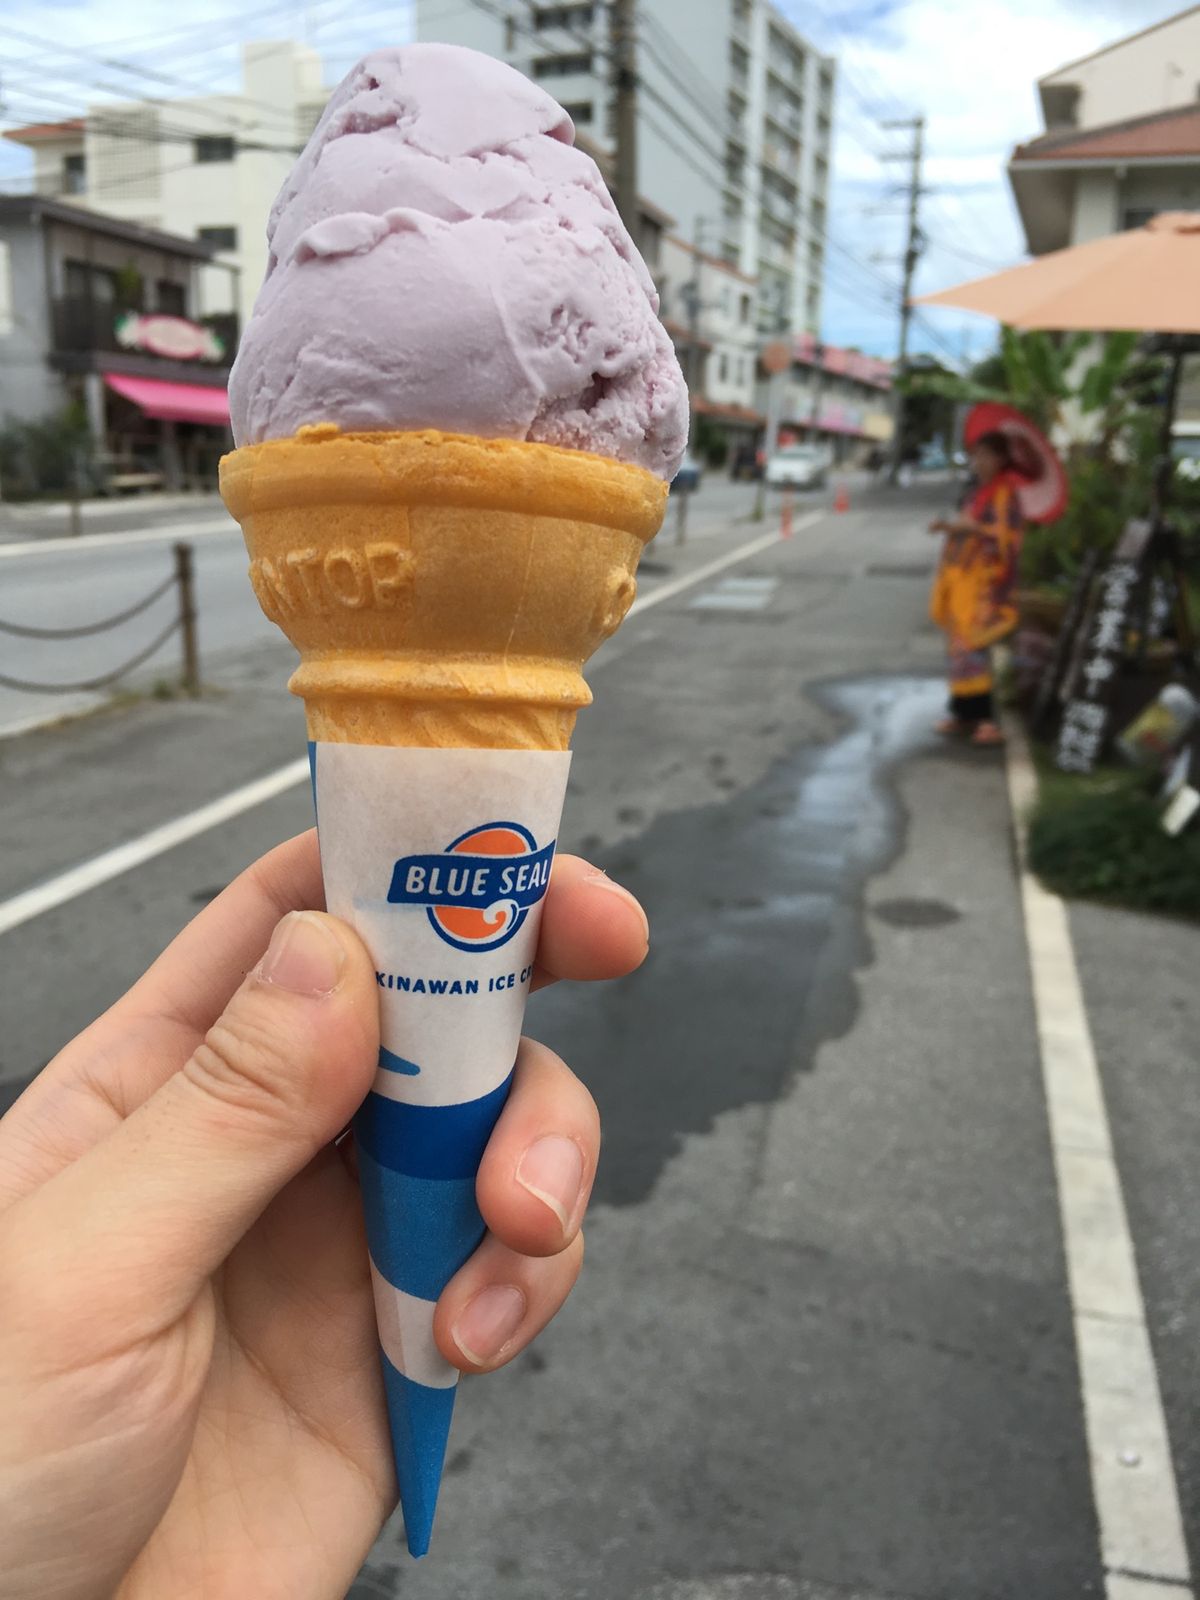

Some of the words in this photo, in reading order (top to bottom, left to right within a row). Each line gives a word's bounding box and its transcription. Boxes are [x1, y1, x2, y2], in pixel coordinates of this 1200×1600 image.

[405, 865, 490, 896] BLUE
[499, 859, 548, 894] SEAL
[375, 970, 479, 995] KINAWAN
[488, 973, 515, 992] ICE
